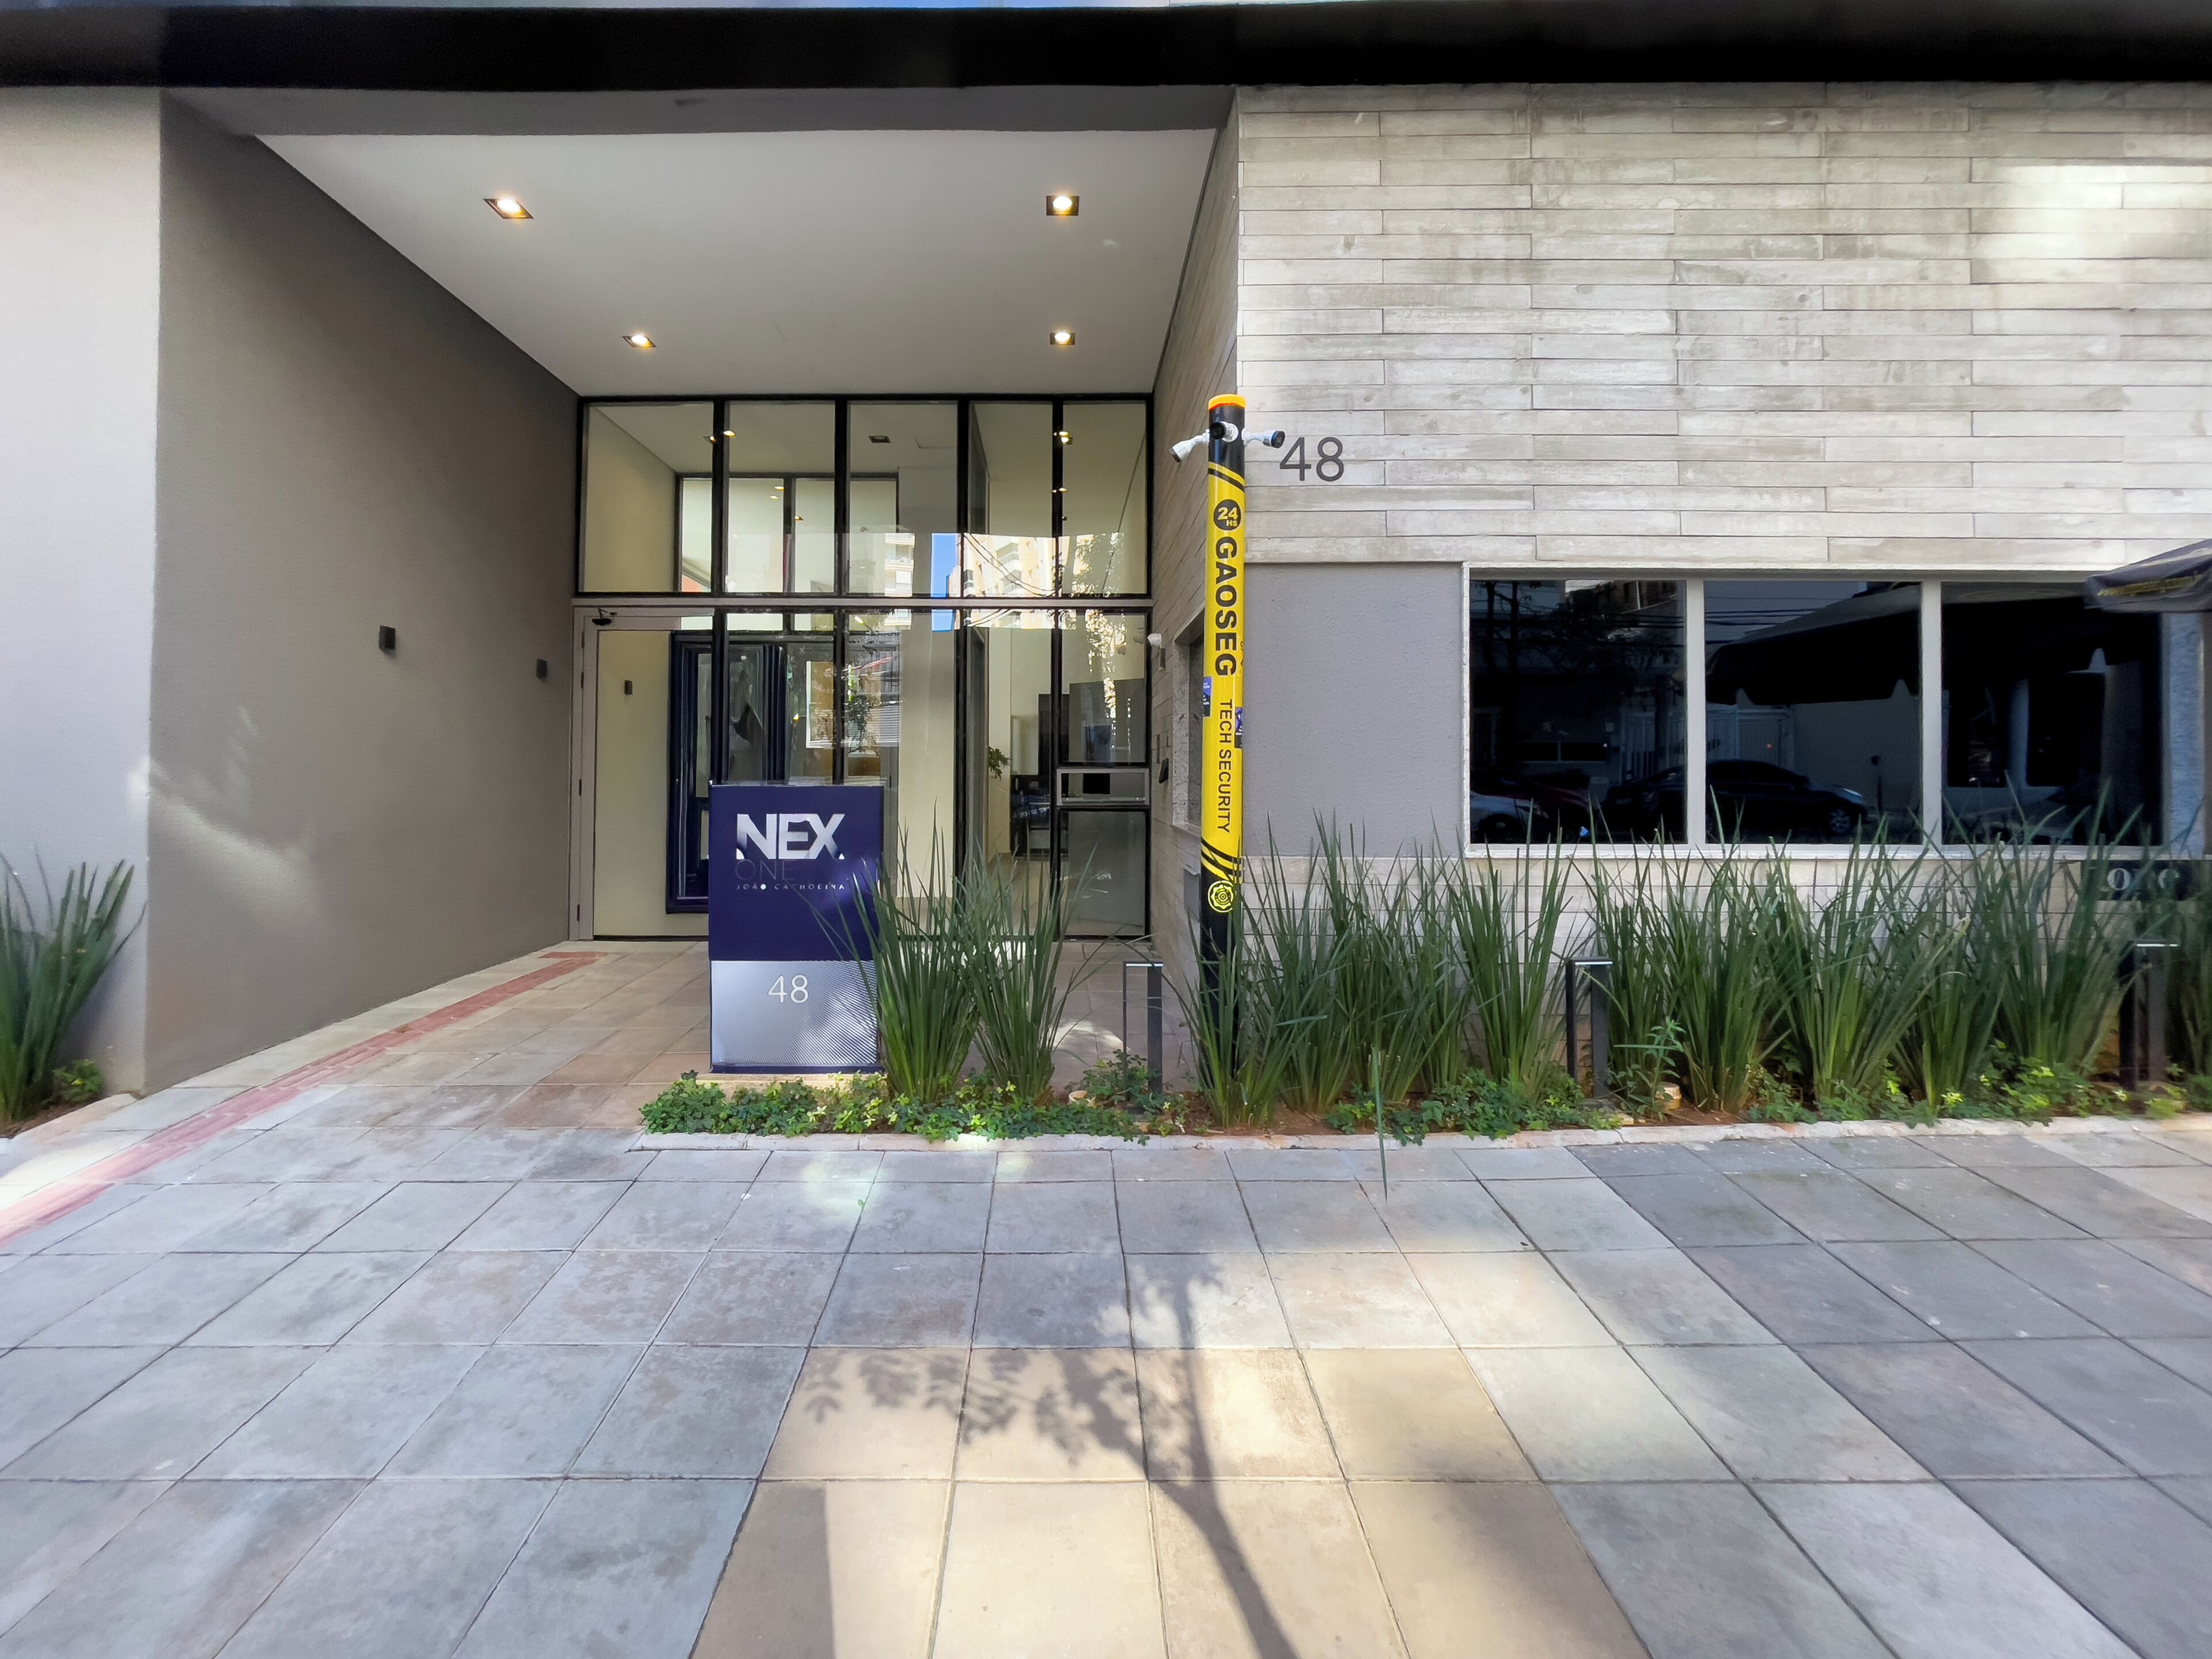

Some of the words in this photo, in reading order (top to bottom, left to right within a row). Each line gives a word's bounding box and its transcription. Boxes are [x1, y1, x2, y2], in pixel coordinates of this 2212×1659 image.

[1279, 436, 1344, 482] 48
[1217, 507, 1238, 520] 24
[1215, 536, 1237, 676] GAOSEG
[1219, 699, 1232, 743] TECH
[1217, 749, 1232, 834] SECURITY
[736, 813, 846, 859] NEX
[735, 859, 796, 880] ONE
[768, 975, 809, 1003] 48
